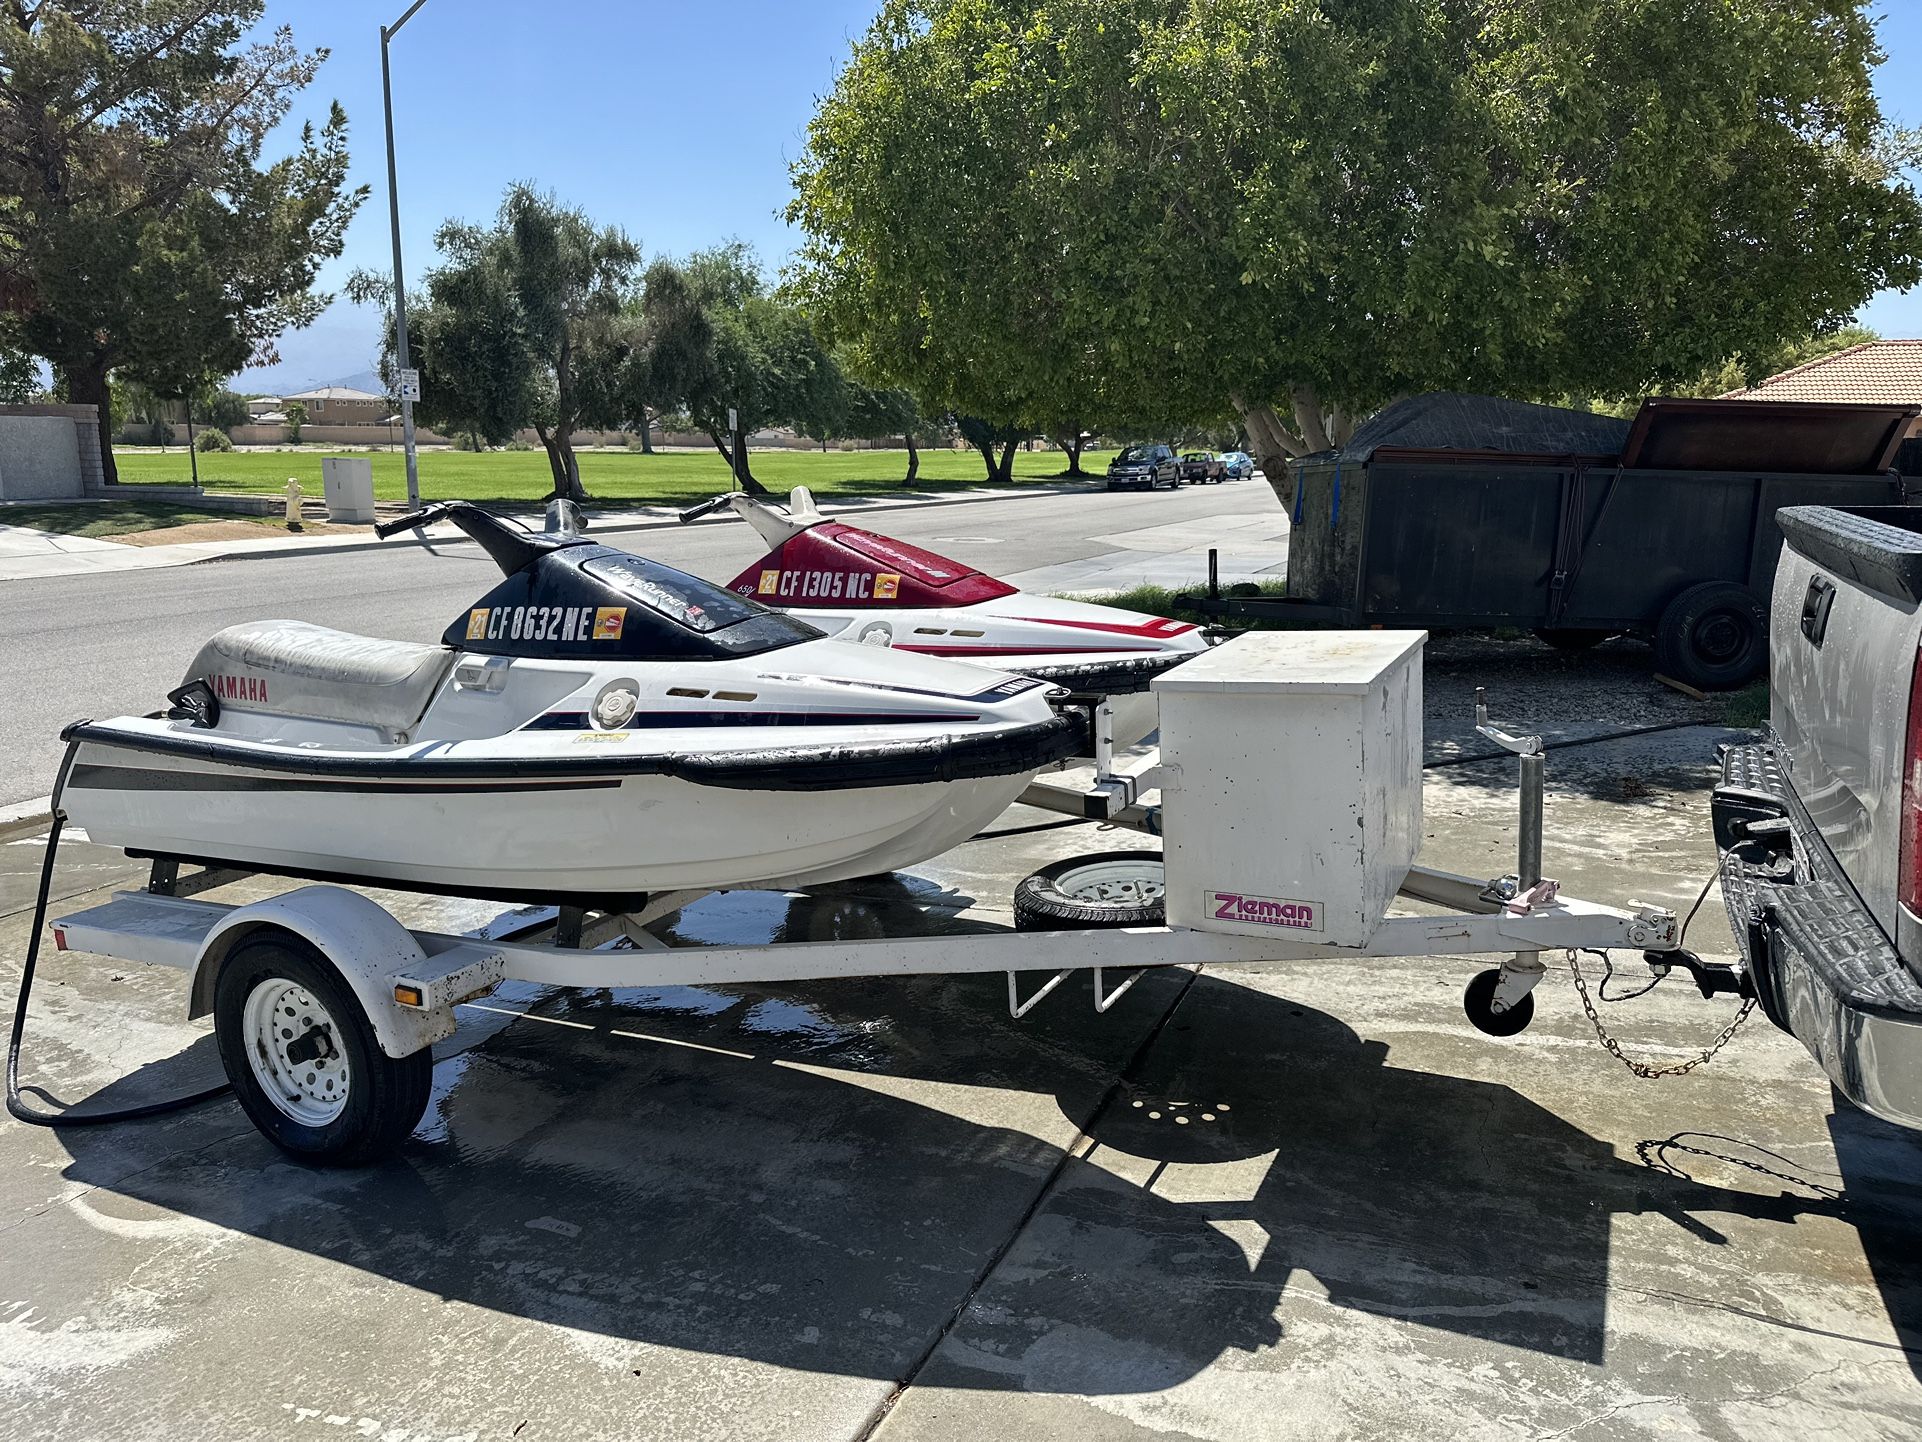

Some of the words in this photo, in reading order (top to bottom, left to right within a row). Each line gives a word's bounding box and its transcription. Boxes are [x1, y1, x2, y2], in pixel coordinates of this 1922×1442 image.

[607, 565, 687, 606] WaveRunner
[780, 571, 800, 596] CF
[802, 571, 844, 597] 1305
[845, 572, 871, 598] NC
[208, 674, 268, 702] YAMAHA
[1215, 894, 1312, 921] Zieman
